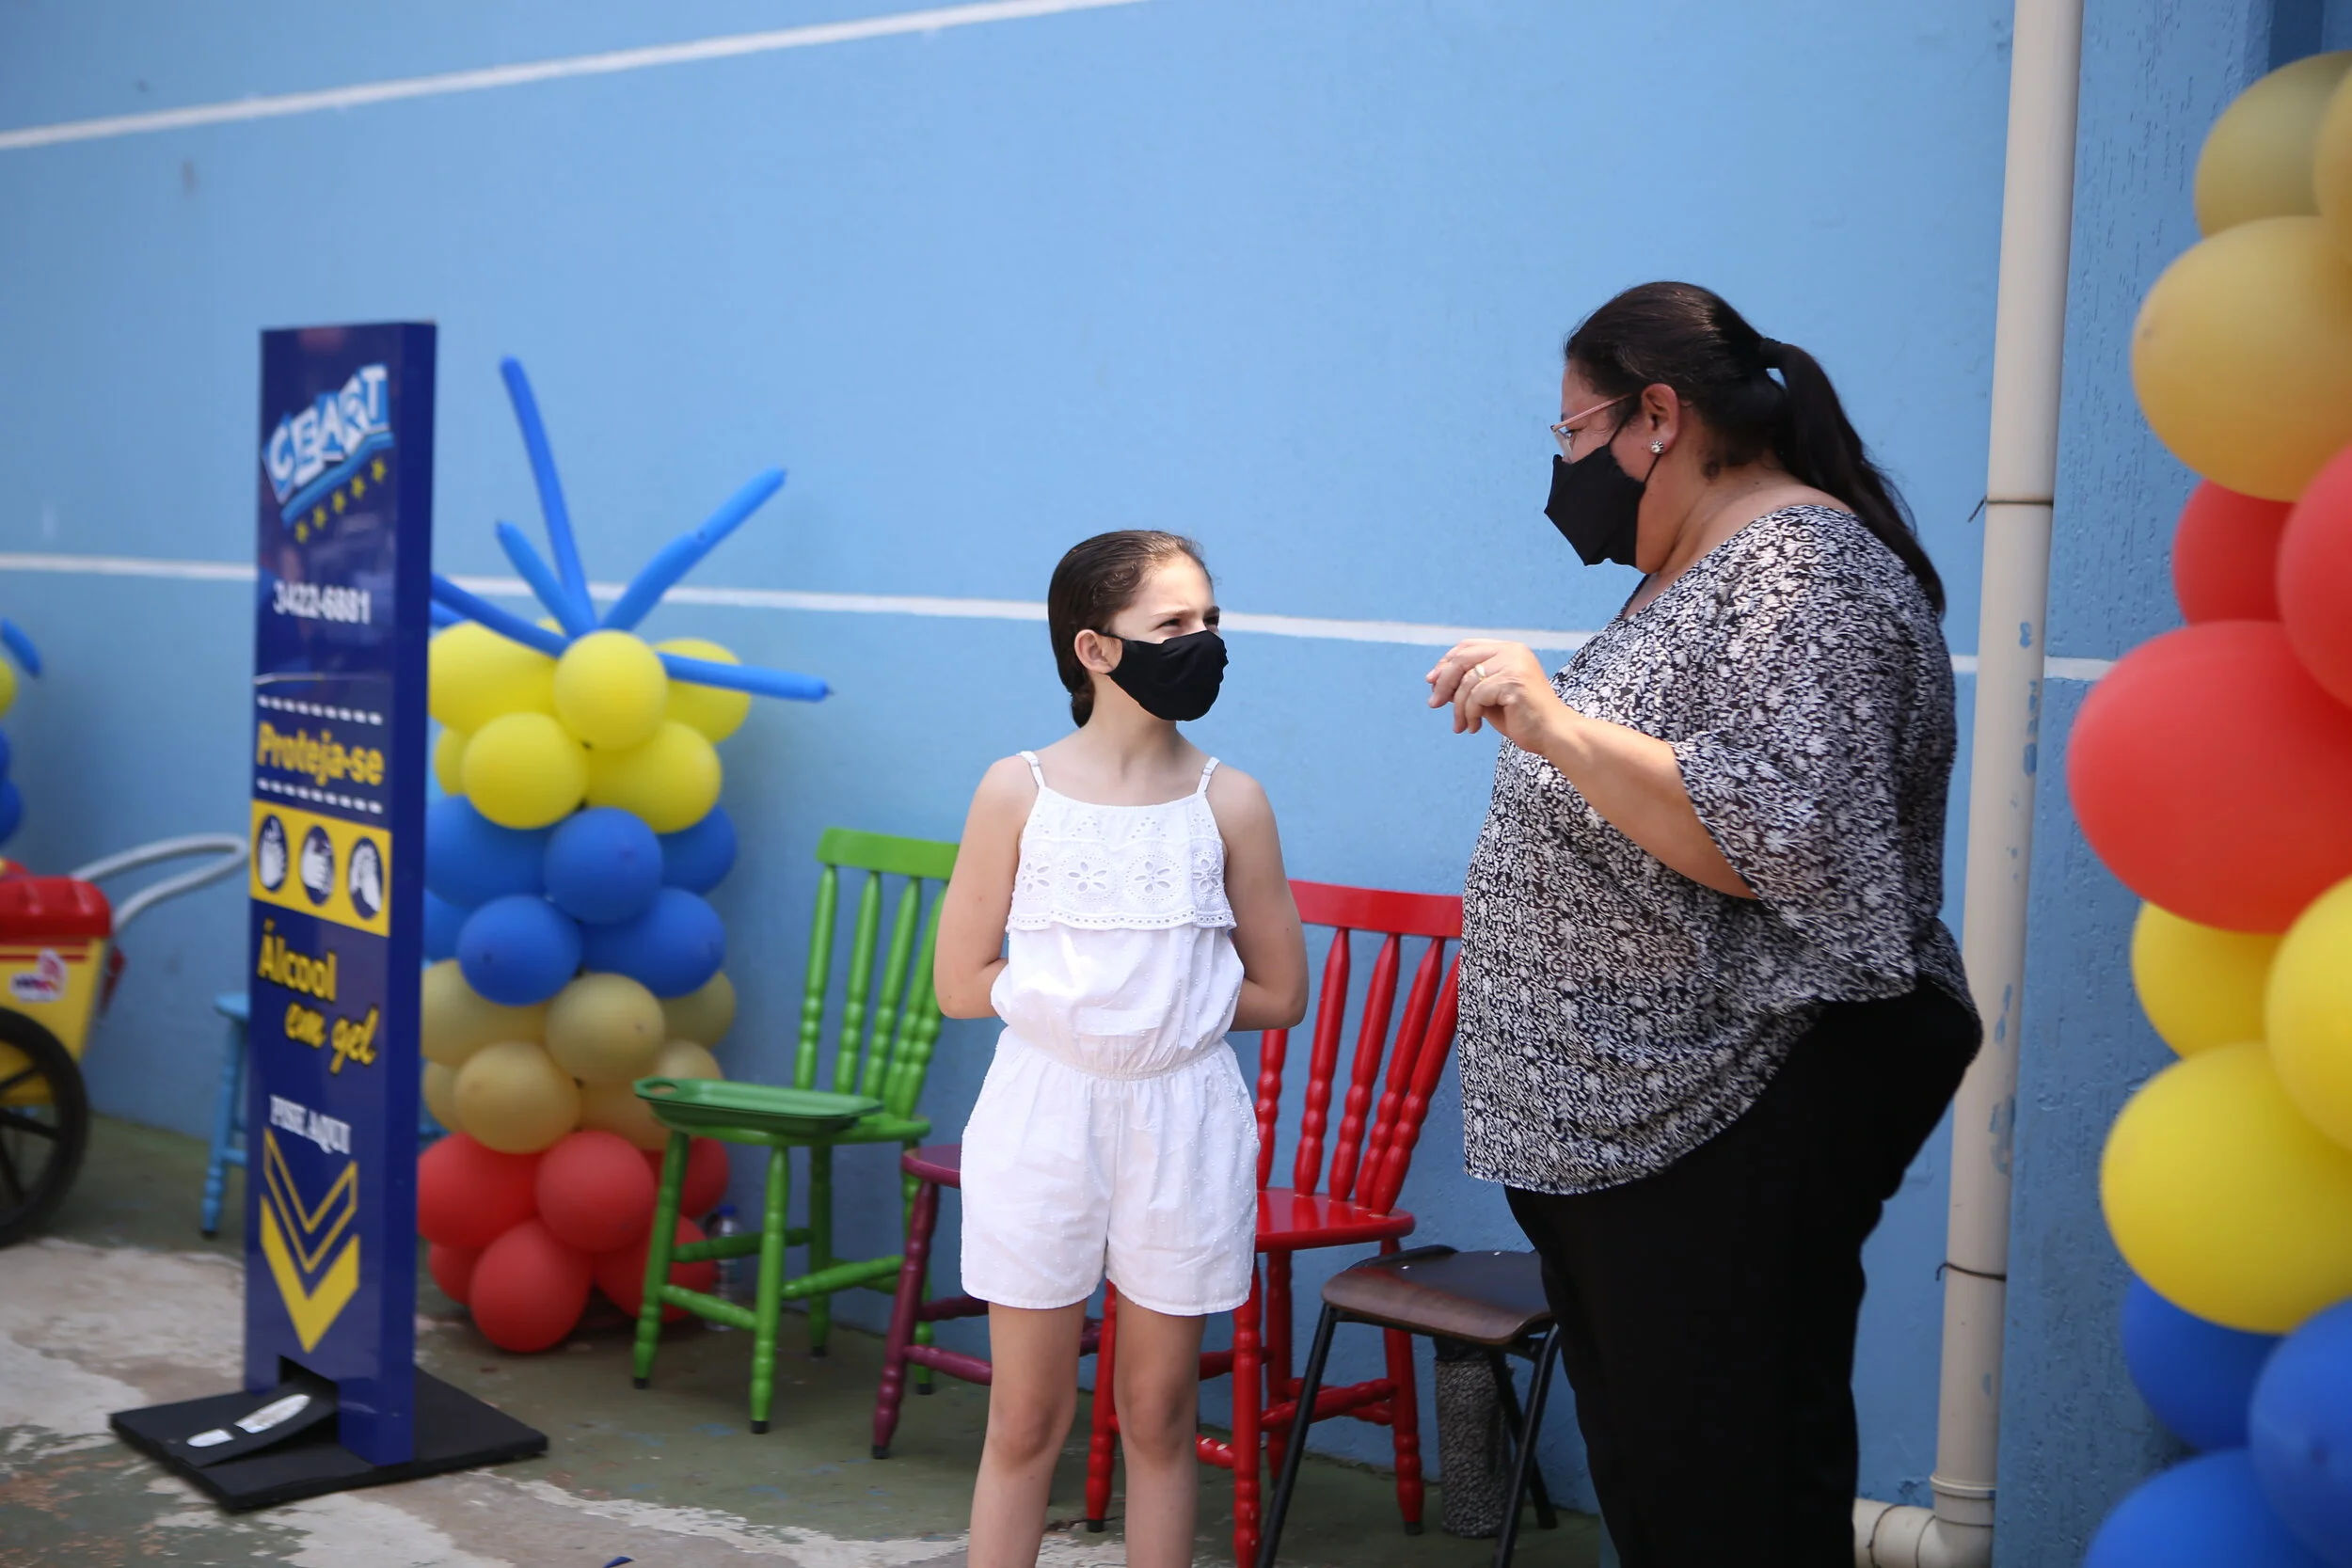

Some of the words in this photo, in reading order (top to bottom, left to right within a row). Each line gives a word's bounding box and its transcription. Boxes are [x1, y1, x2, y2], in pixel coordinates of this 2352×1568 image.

[257, 721, 385, 786] Proteja-se
[257, 919, 337, 1001] Álcool
[285, 1002, 326, 1049] em
[330, 1006, 379, 1075] gel
[269, 1094, 306, 1136] PISE
[306, 1108, 351, 1154] AQUI
